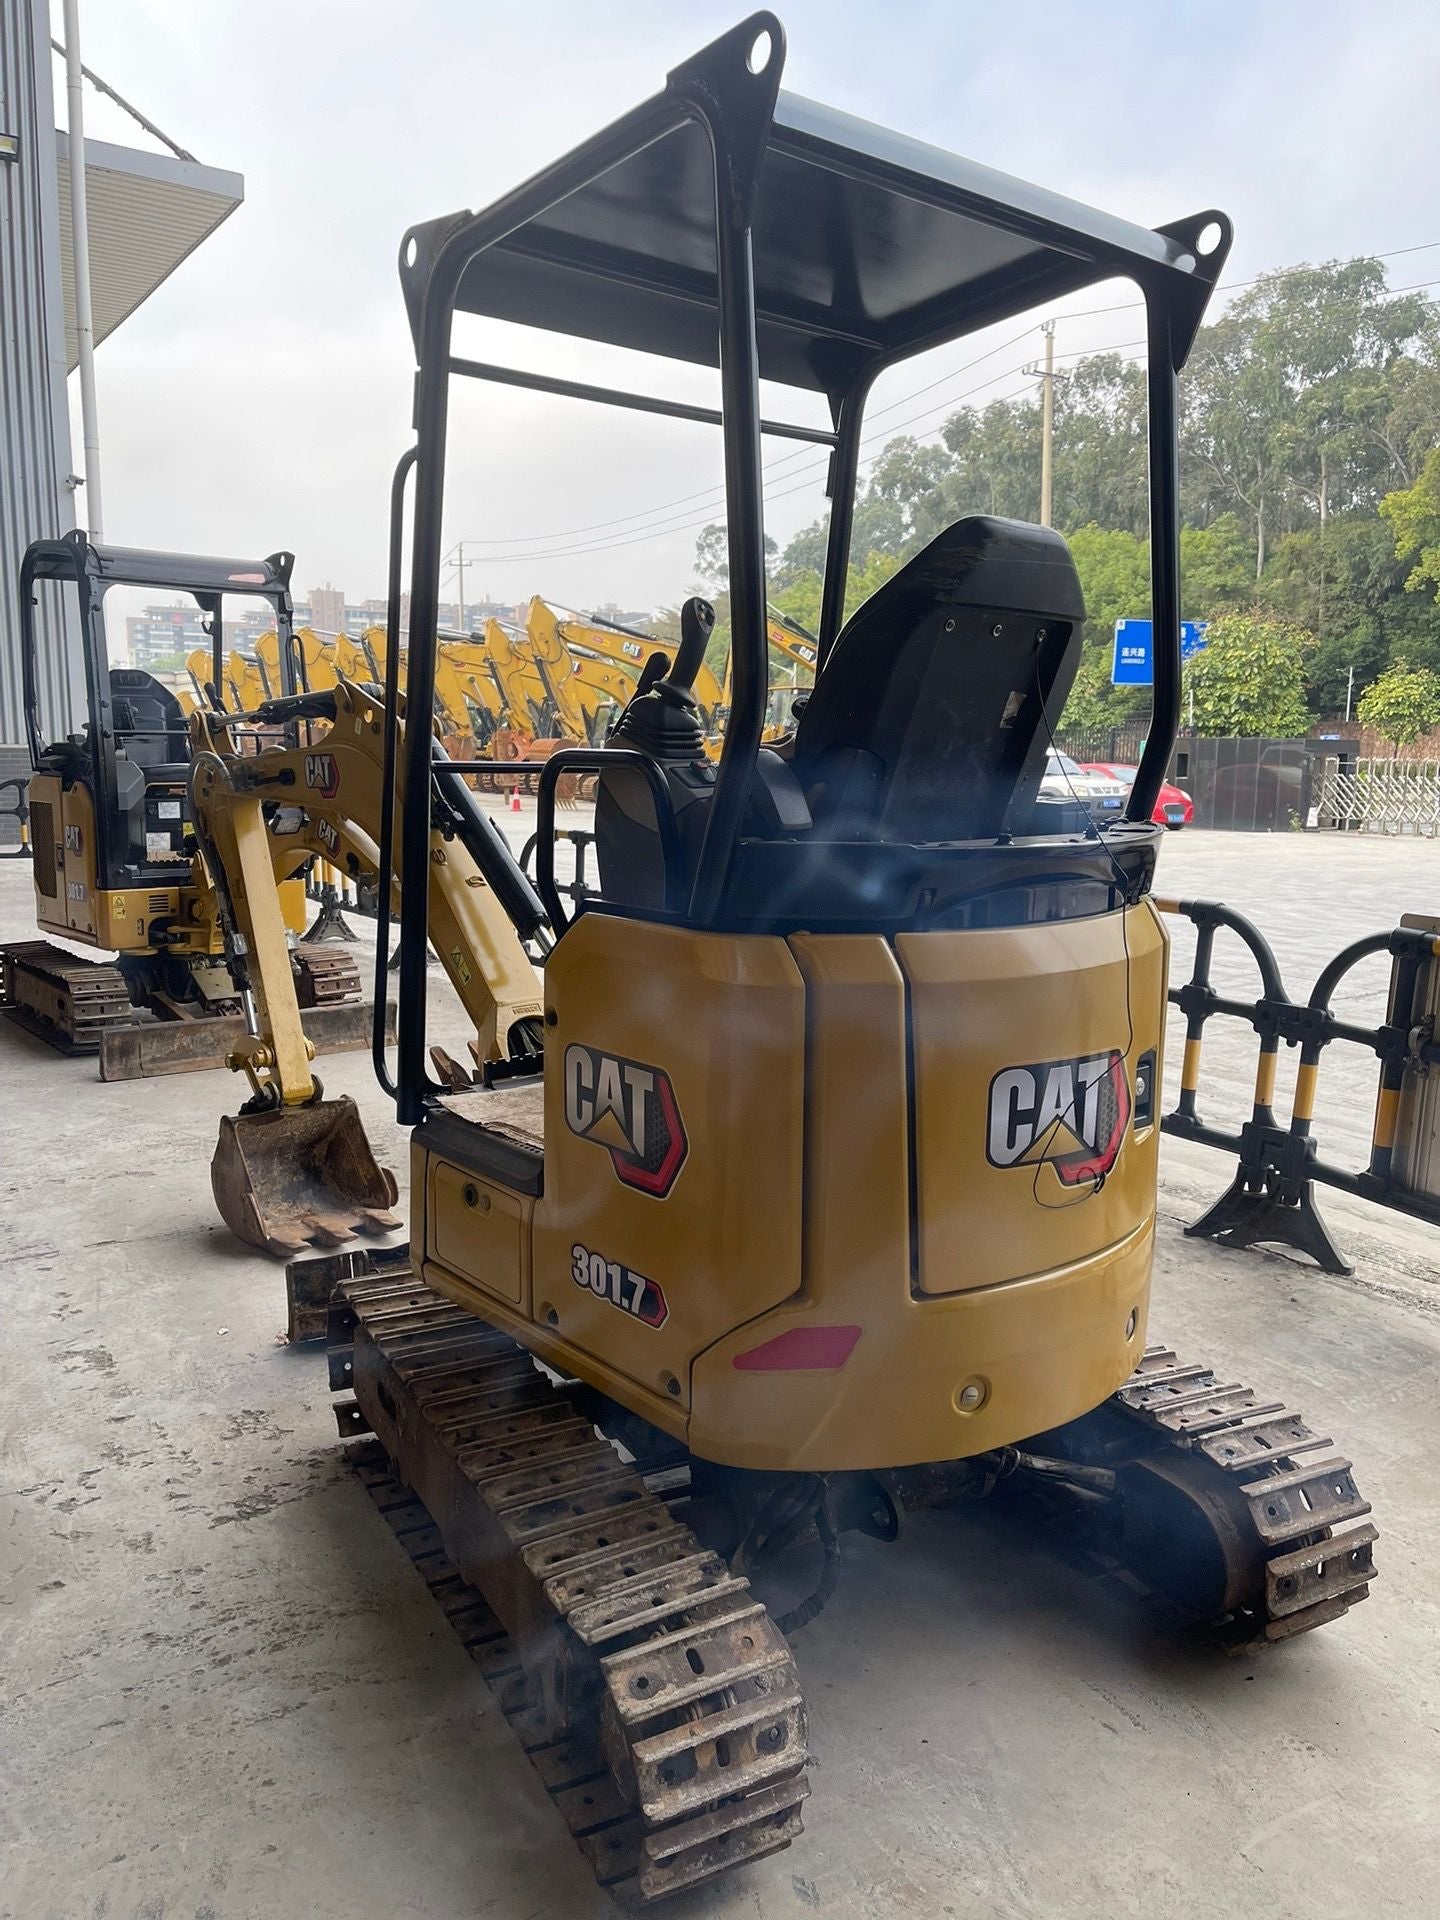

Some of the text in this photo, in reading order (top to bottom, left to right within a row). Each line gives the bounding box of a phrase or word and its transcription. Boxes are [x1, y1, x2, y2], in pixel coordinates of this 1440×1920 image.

[622, 641, 641, 657] CAT
[798, 645, 814, 661] CAT
[305, 755, 331, 788] CAT
[65, 825, 80, 850] CAT
[319, 818, 338, 850] CAT
[565, 1045, 654, 1158] CAT
[990, 1057, 1109, 1165] CAT
[572, 1245, 646, 1315] 301.7
